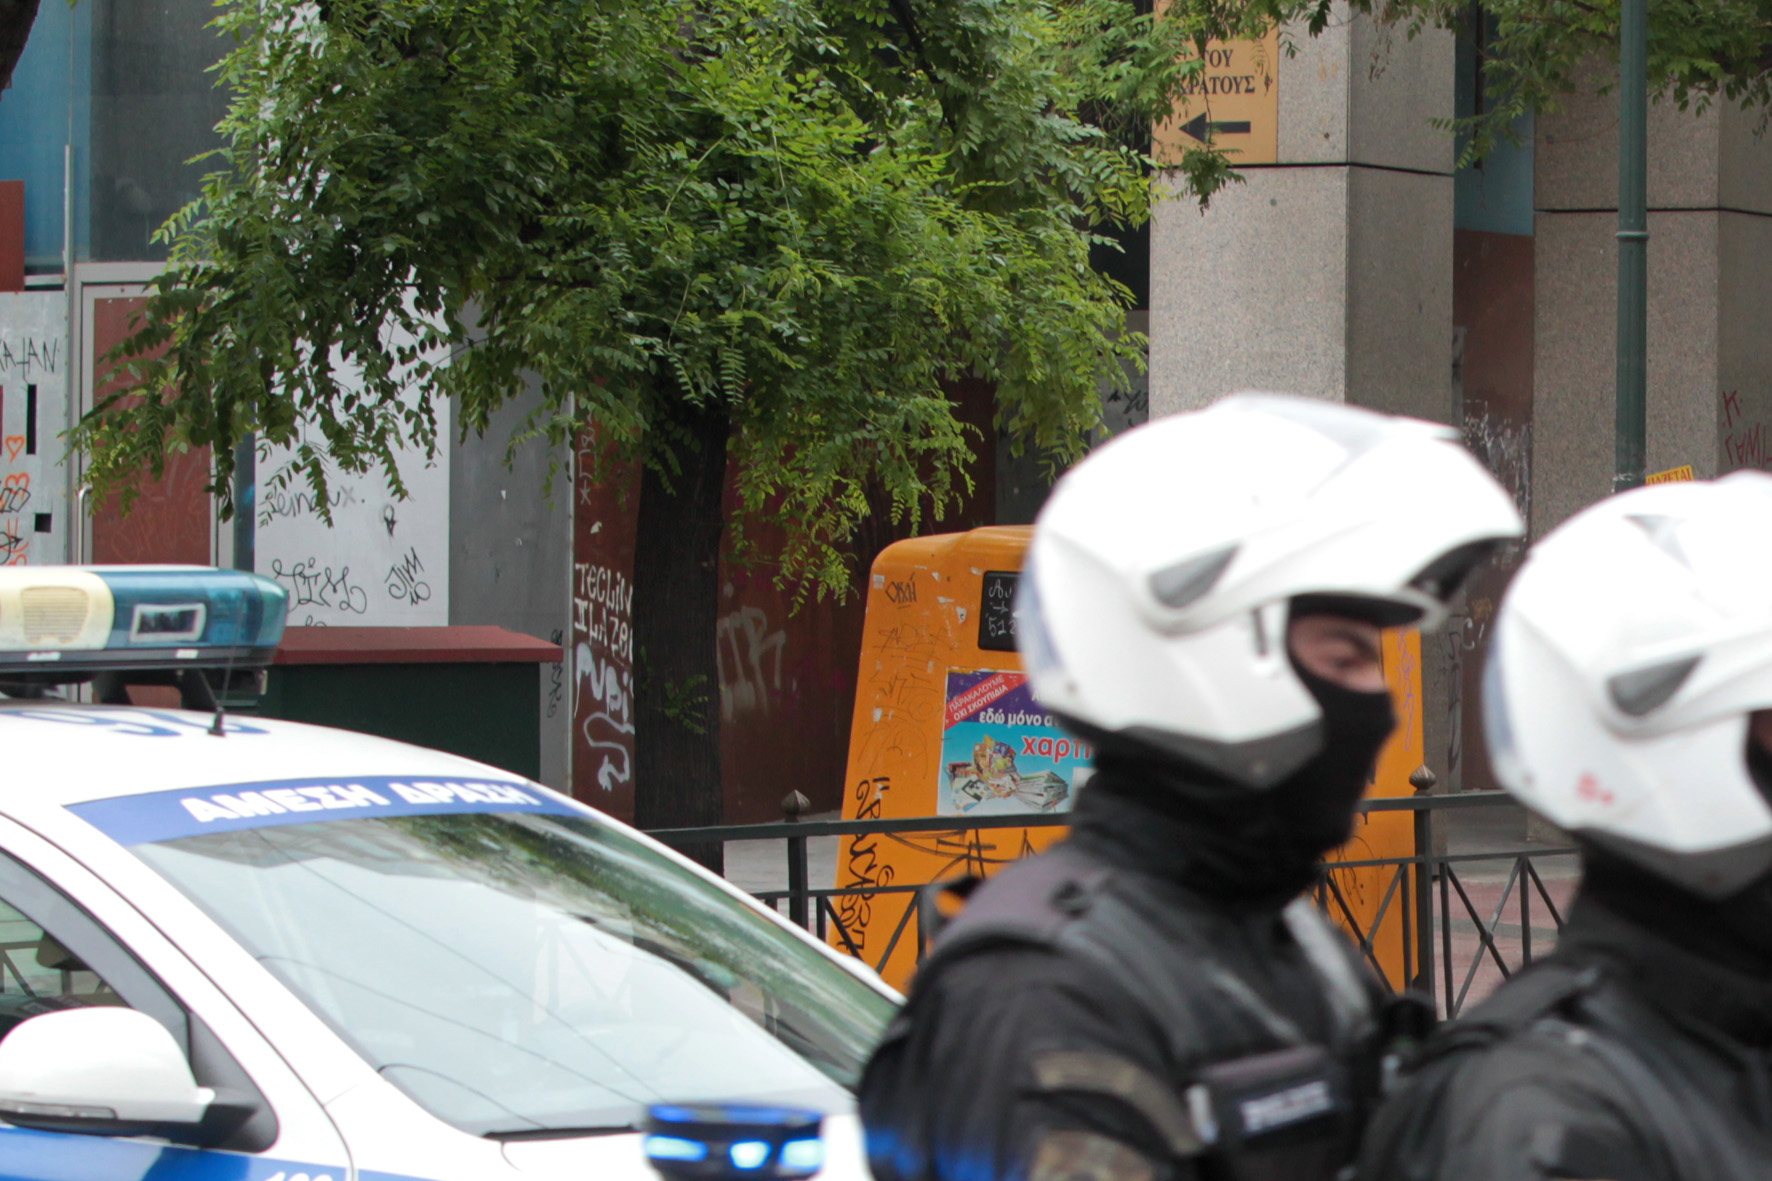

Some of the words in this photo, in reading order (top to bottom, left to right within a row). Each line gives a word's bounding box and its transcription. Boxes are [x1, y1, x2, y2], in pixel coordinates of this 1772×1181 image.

[948, 674, 1005, 713] ΠΑΡΑΚΑΛΟΥΜΕ
[953, 707, 968, 721] ΟΧΙ
[967, 684, 1008, 713] ΣΚΟΥΠΙΔΙΑ
[979, 707, 1005, 724] εδώ
[1007, 709, 1042, 728] μόνο
[1021, 734, 1098, 764] χαρτι
[180, 784, 391, 822] ΑΜΕΣΗ
[388, 782, 542, 806] ΔΡΑΣΗ
